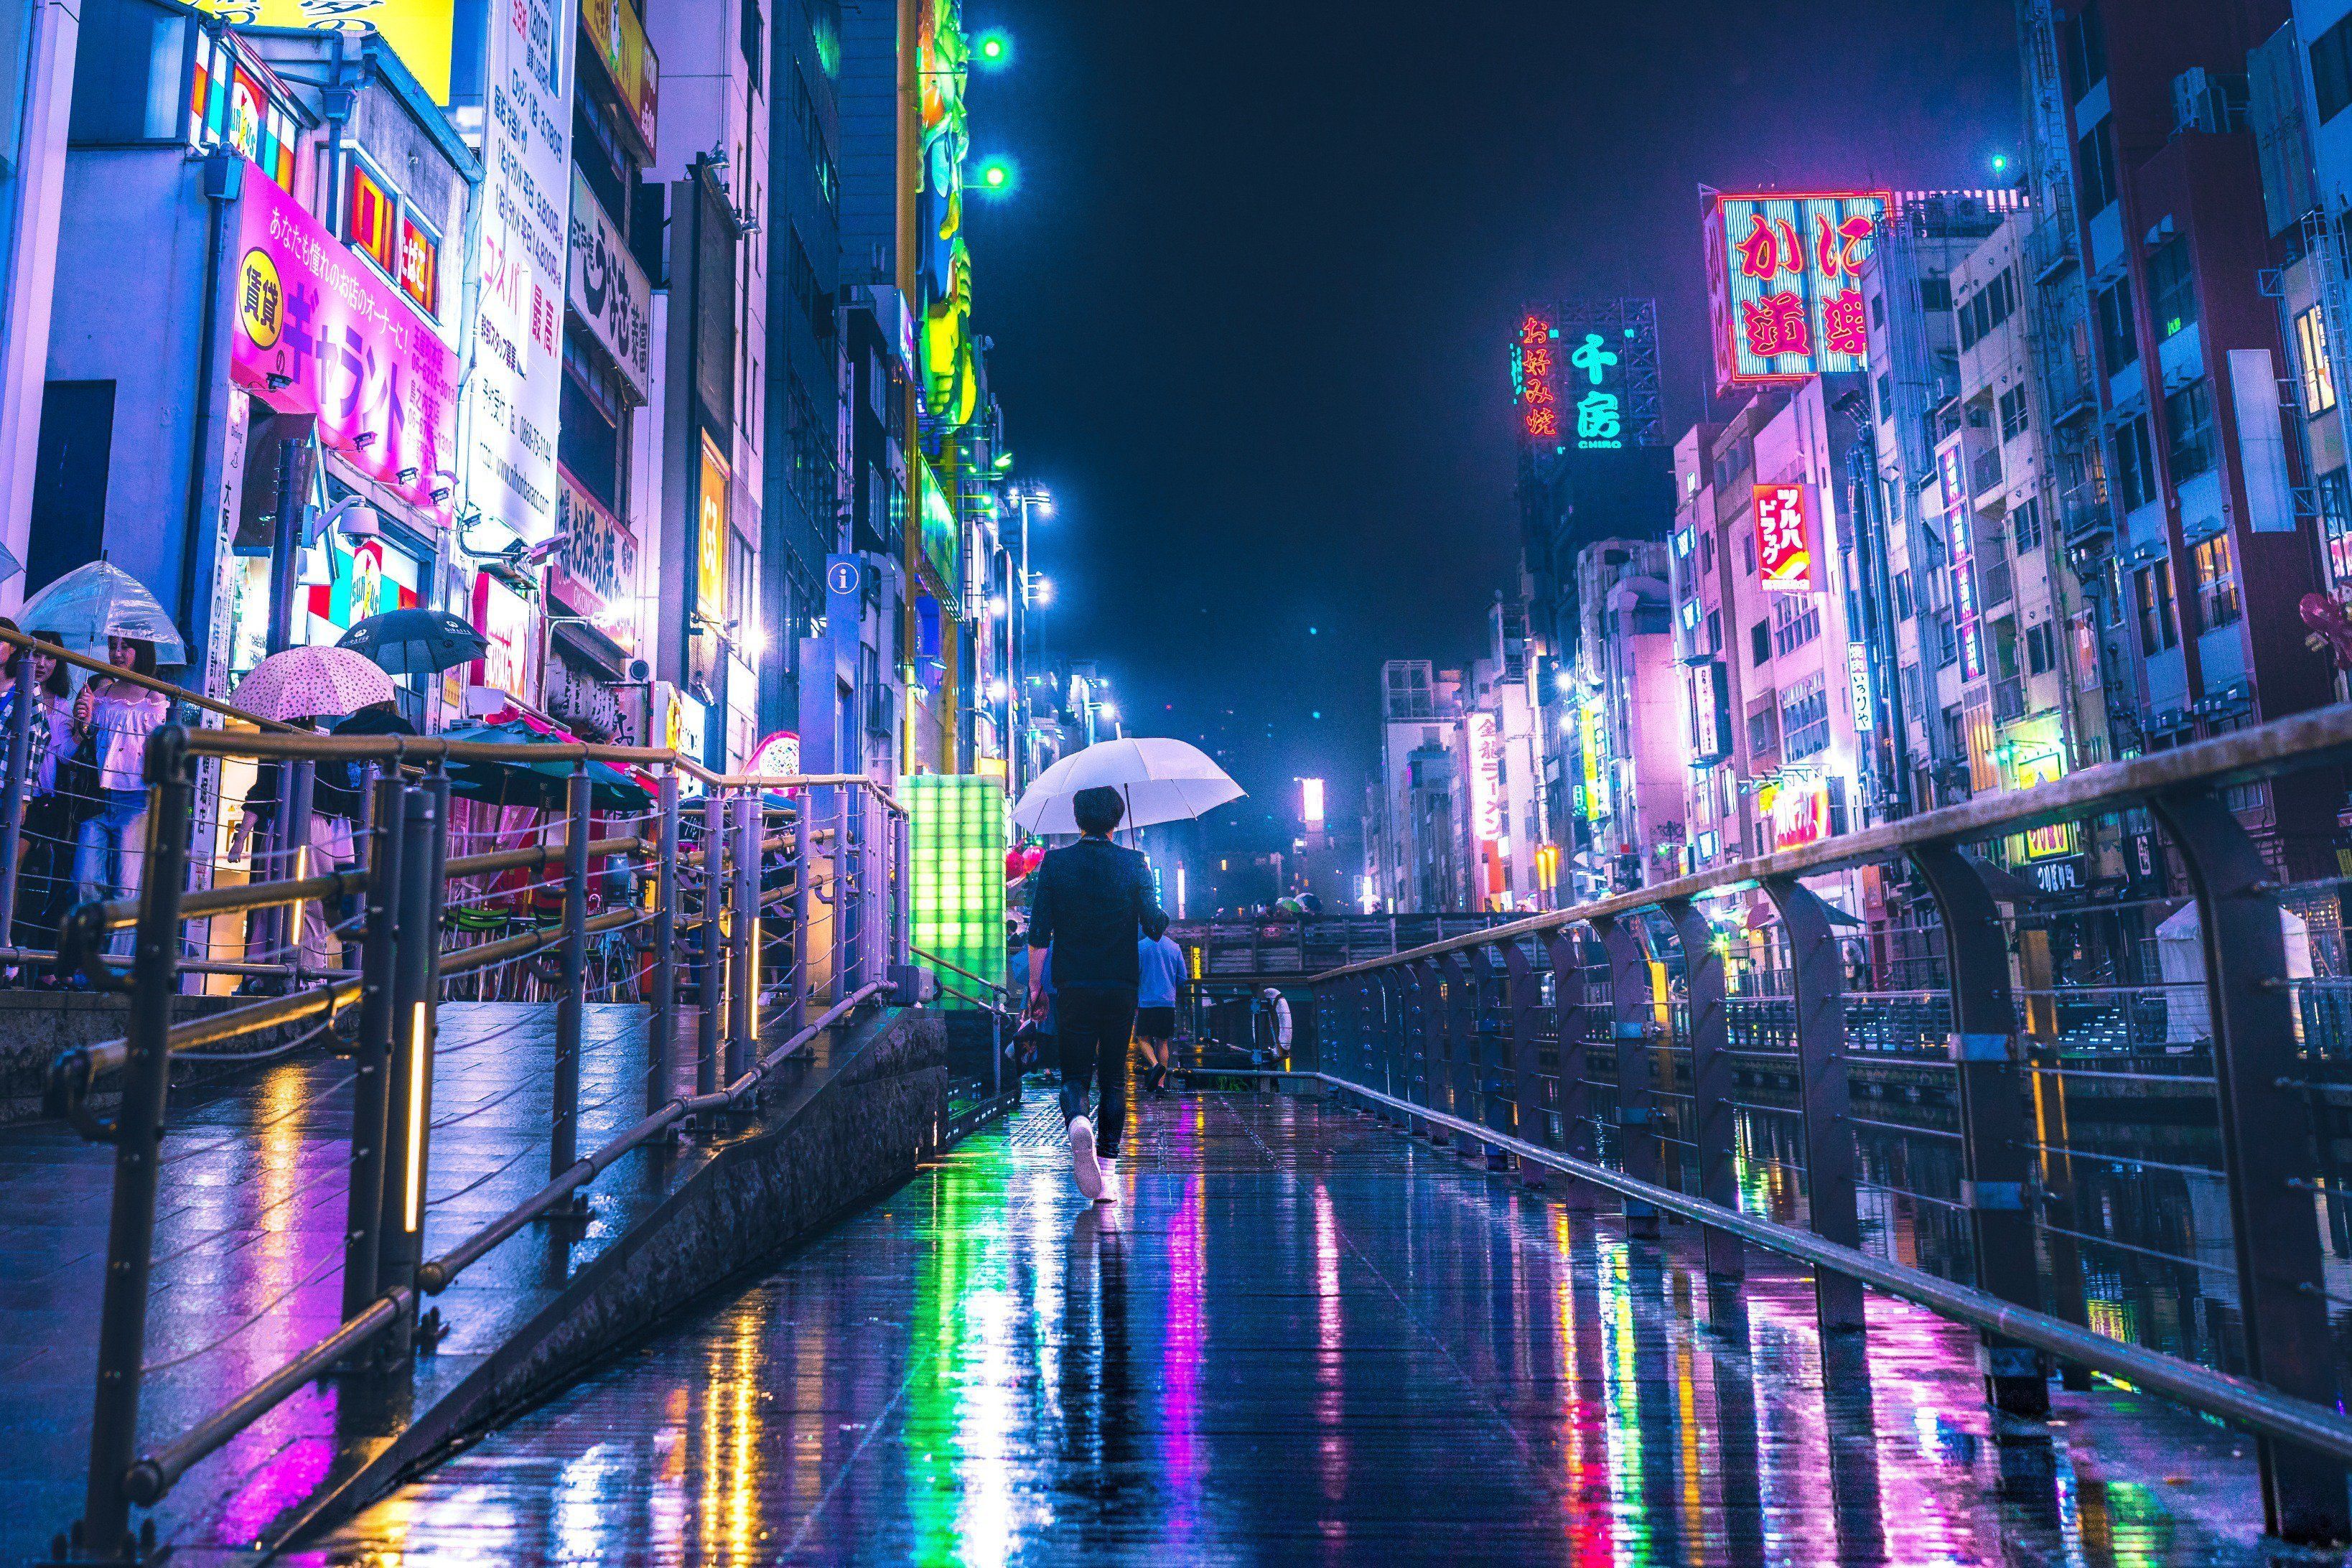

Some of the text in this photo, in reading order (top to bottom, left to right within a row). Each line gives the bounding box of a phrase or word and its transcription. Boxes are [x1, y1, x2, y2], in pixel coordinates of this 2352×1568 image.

[540, 110, 562, 164] 3,780円
[1735, 213, 1875, 281] かに
[245, 264, 279, 335] 賃貸
[276, 350, 285, 375] の
[1523, 317, 1557, 435] お好み焼
[1572, 334, 1620, 438] 千房
[1759, 500, 1781, 565] ドラッグ
[1777, 490, 1803, 549] ツルハ
[1854, 676, 1868, 727] いろりや
